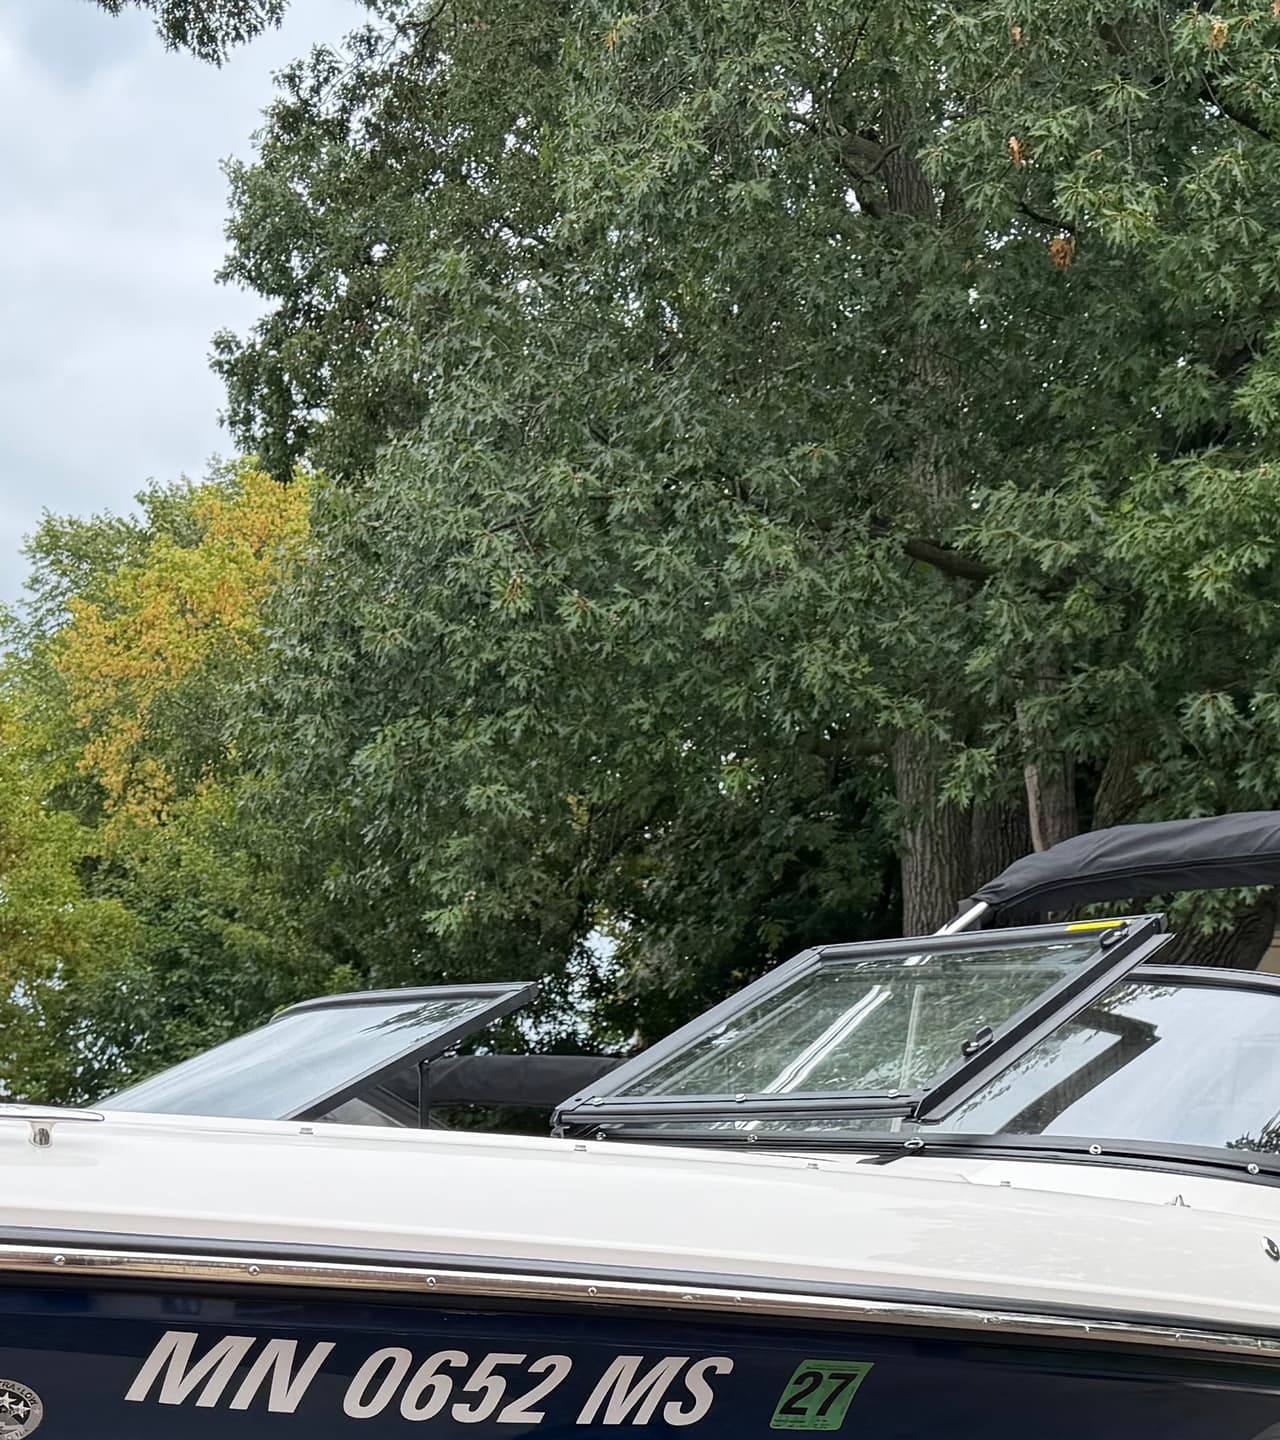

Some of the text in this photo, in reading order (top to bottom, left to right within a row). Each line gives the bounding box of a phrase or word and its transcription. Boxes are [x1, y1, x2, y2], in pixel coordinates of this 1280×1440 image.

[125, 1331, 734, 1426] MN 0652 MS
[779, 1371, 858, 1416] 27
